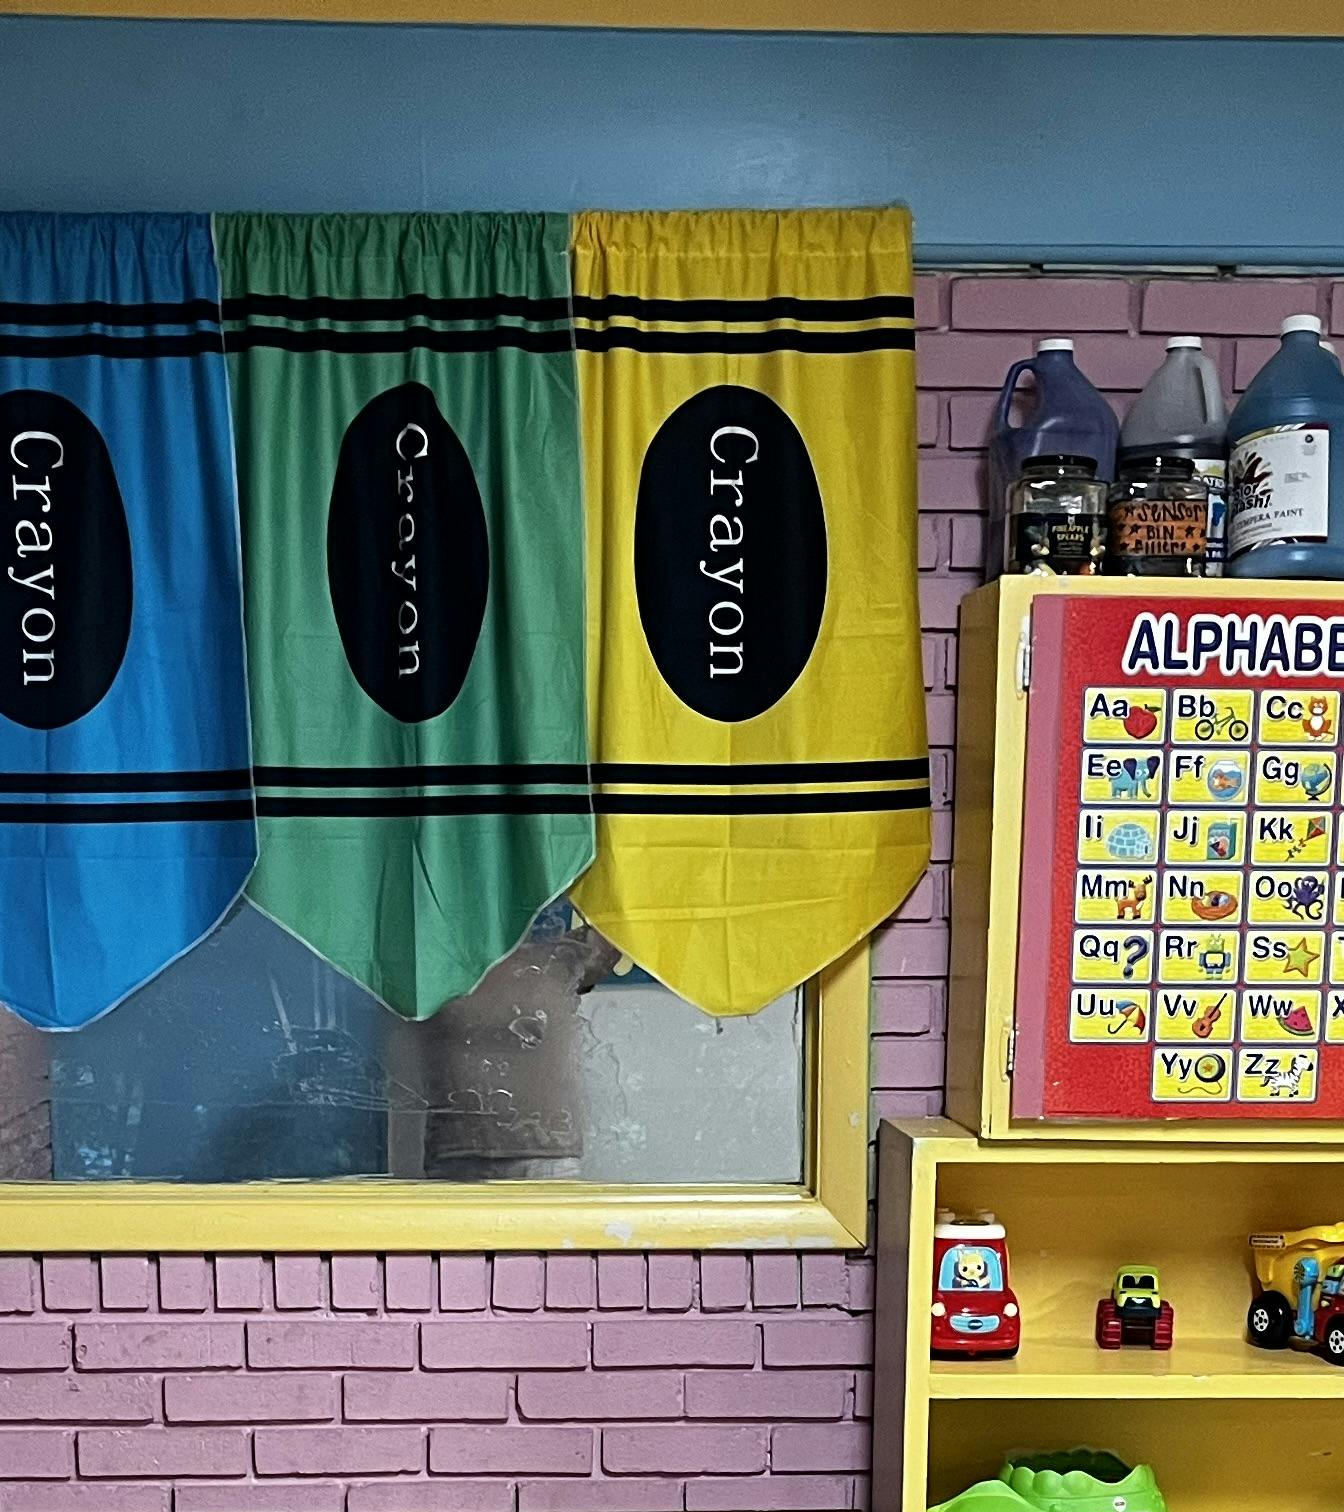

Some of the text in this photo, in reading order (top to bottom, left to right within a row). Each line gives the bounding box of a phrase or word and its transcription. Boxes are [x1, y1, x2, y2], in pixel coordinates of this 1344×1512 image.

[8, 430, 64, 686] Crayon
[700, 425, 759, 679] Crayon
[1089, 696, 1129, 718] Aa
[1178, 696, 1215, 718] Bb
[1266, 696, 1303, 719] Cc
[1088, 756, 1121, 778] Ee
[1176, 756, 1204, 778] Ff
[1262, 757, 1299, 786] Gg
[1085, 816, 1102, 839] Ii
[1173, 818, 1198, 847] Jj
[1259, 818, 1293, 841] Kk
[1082, 876, 1128, 898] Mm
[1169, 876, 1204, 898] Nn
[1256, 877, 1292, 898] Oo
[1079, 935, 1118, 964] Qq
[1166, 936, 1197, 959] Rr
[1253, 936, 1286, 959] Ss
[1077, 995, 1114, 1017] Uu
[1164, 995, 1196, 1018] Vv
[1249, 996, 1292, 1018] Ww
[1161, 1053, 1192, 1081] Yy
[1245, 1054, 1280, 1077] Zz
